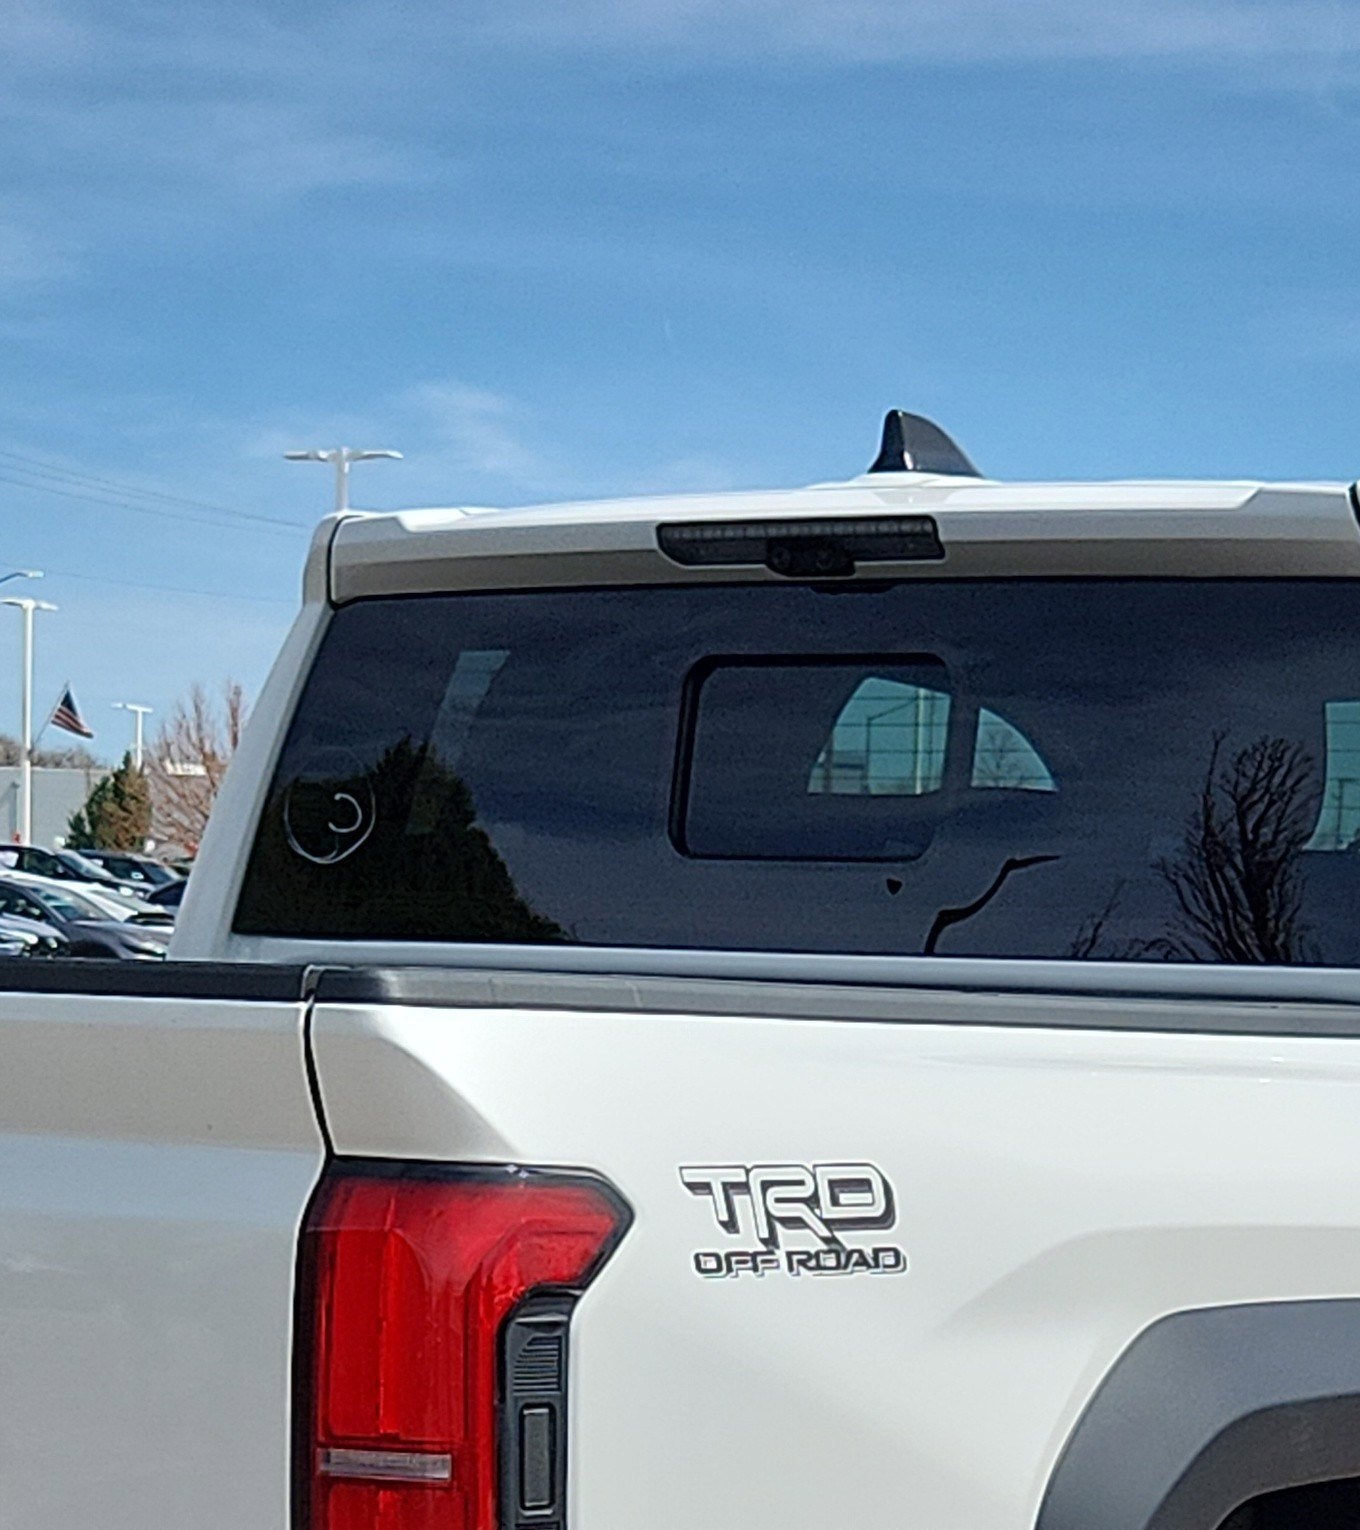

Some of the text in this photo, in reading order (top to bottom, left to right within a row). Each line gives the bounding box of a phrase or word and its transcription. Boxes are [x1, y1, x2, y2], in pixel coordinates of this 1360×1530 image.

[678, 1162, 897, 1251] TRD
[693, 1246, 908, 1279] OFF ROAD
